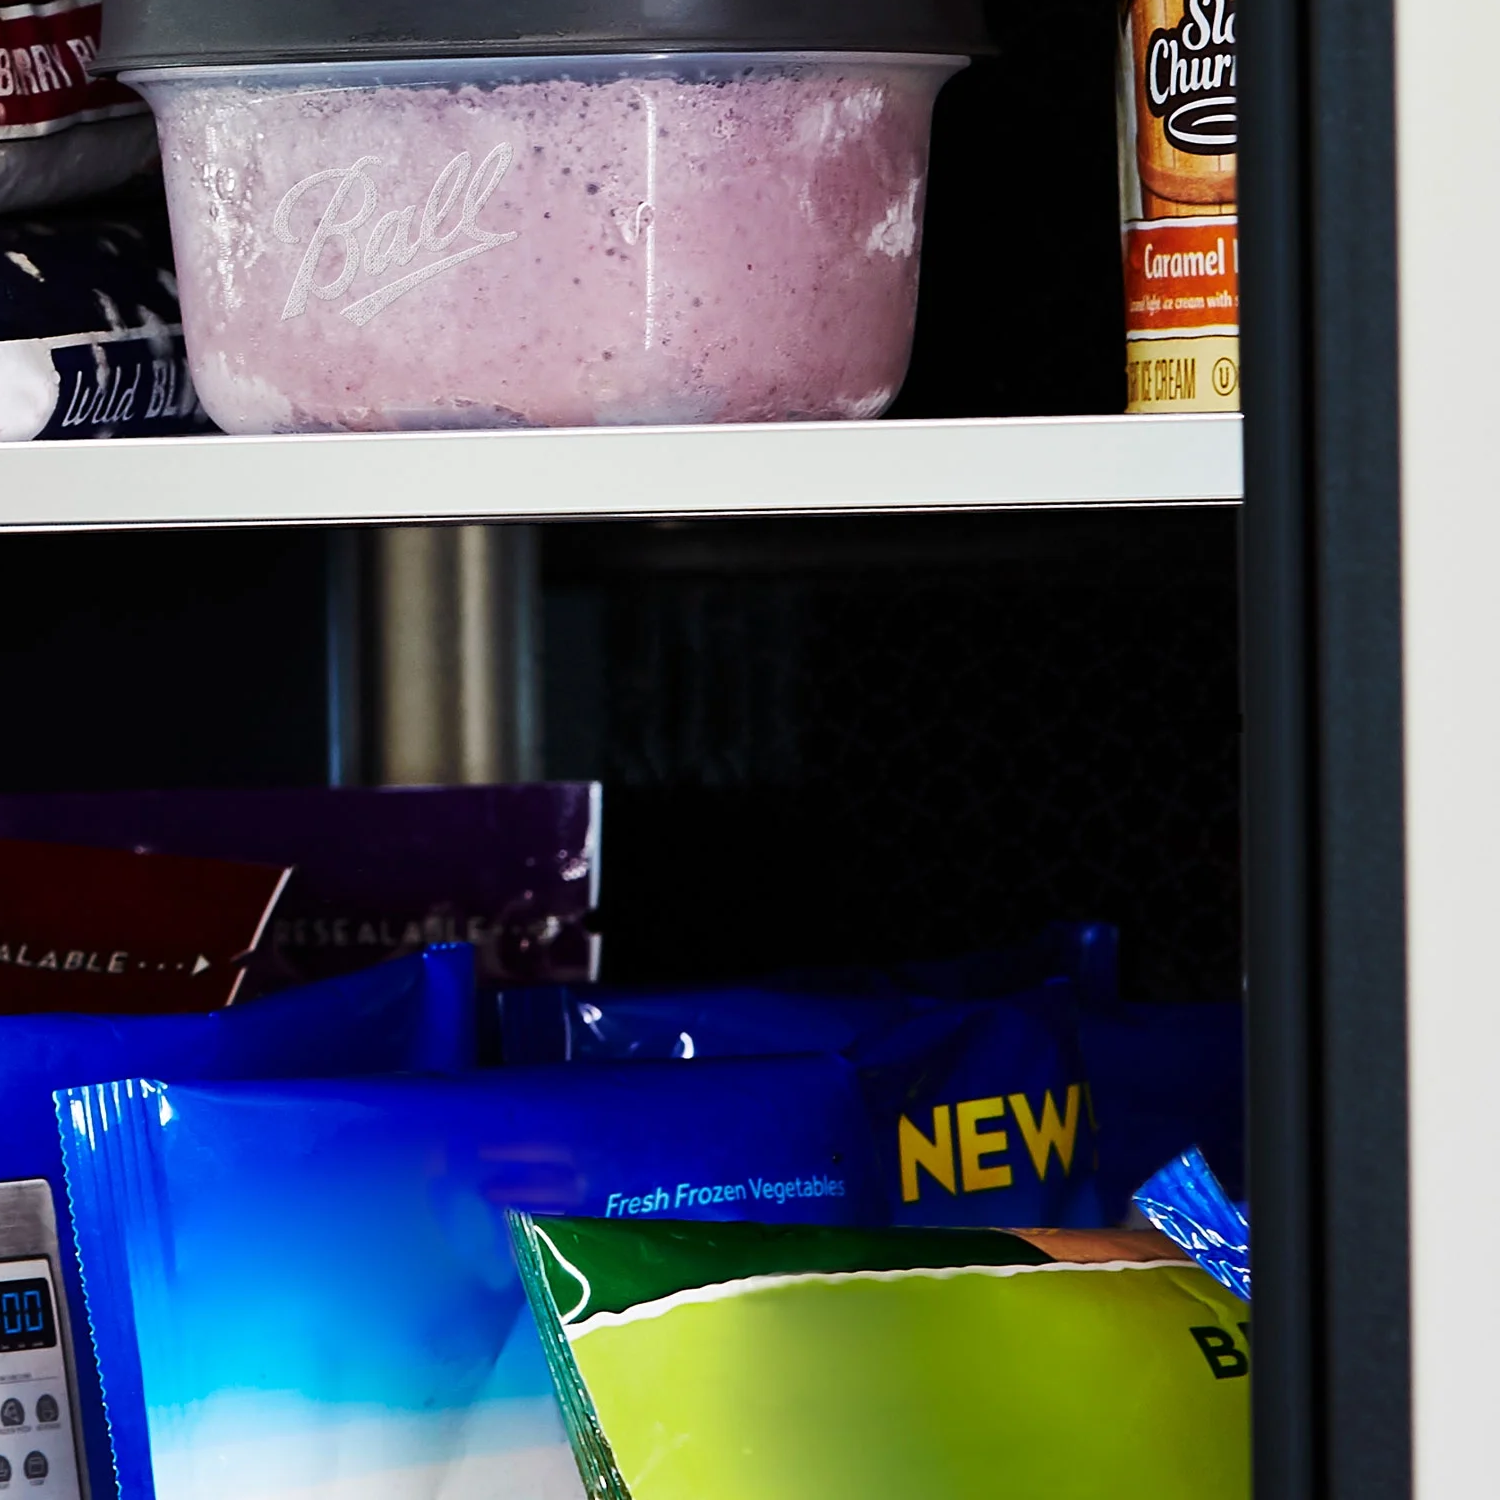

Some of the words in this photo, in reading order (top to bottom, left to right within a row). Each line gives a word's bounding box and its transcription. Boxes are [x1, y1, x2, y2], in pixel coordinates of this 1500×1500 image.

[274, 141, 519, 327] Ball
[1144, 237, 1225, 279] Caramel
[1207, 289, 1233, 308] with
[1155, 358, 1196, 400] CREAM
[605, 1187, 669, 1218] Fresh
[674, 1183, 747, 1208] Frozen
[748, 1174, 846, 1204] Vegetables
